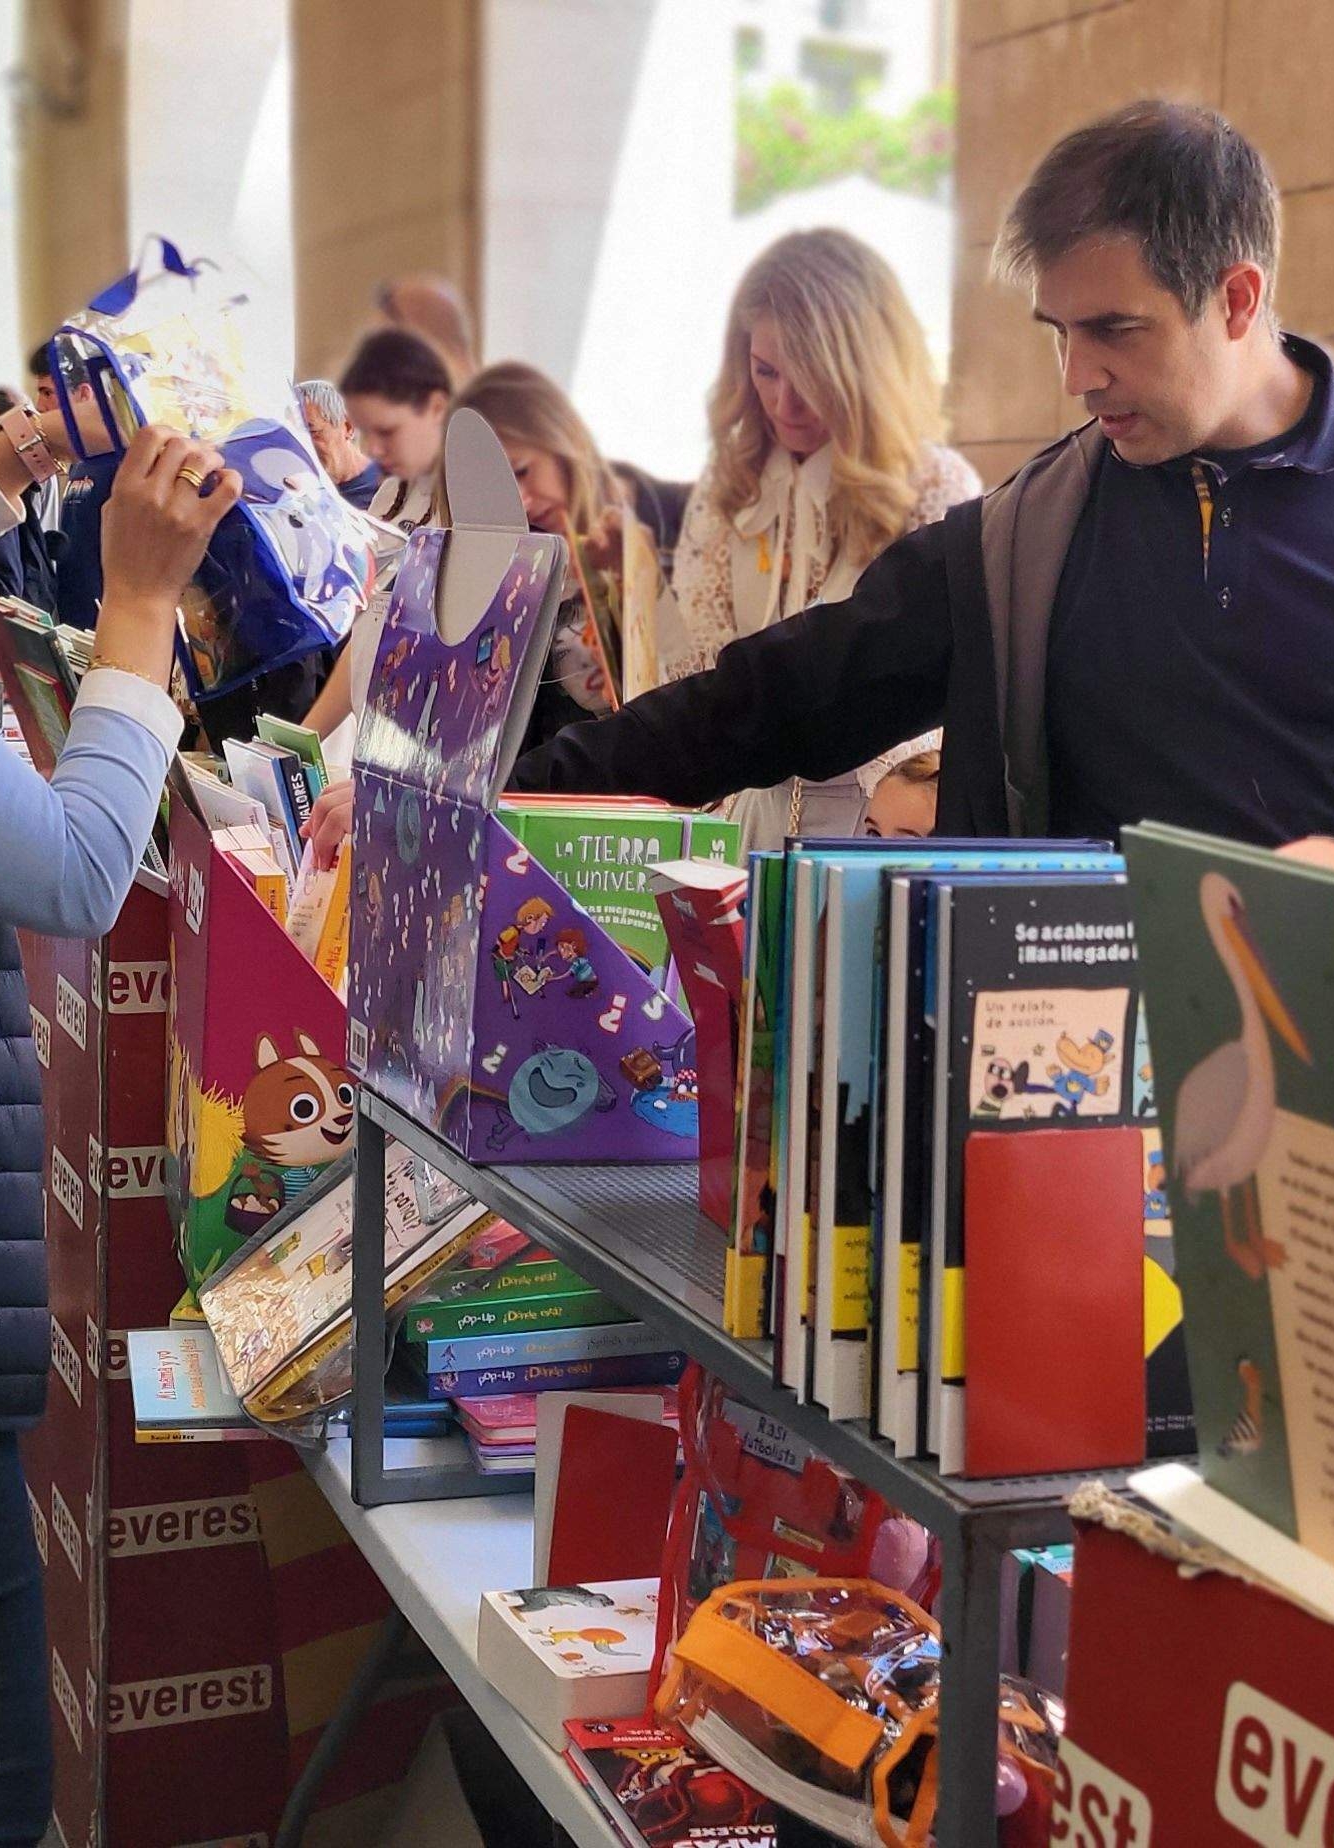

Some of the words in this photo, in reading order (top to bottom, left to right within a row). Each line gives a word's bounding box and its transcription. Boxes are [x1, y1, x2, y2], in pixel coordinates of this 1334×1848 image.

[555, 841, 574, 858] LA
[578, 835, 661, 865] TIERRA
[576, 870, 654, 895] UNIVER
[1015, 922, 1039, 942] Se
[1041, 921, 1126, 941] acabaron
[1060, 943, 1130, 965] llegado
[58, 983, 85, 1046] everest
[106, 1670, 267, 1724] everest
[689, 1823, 778, 1838] DAD.EXE
